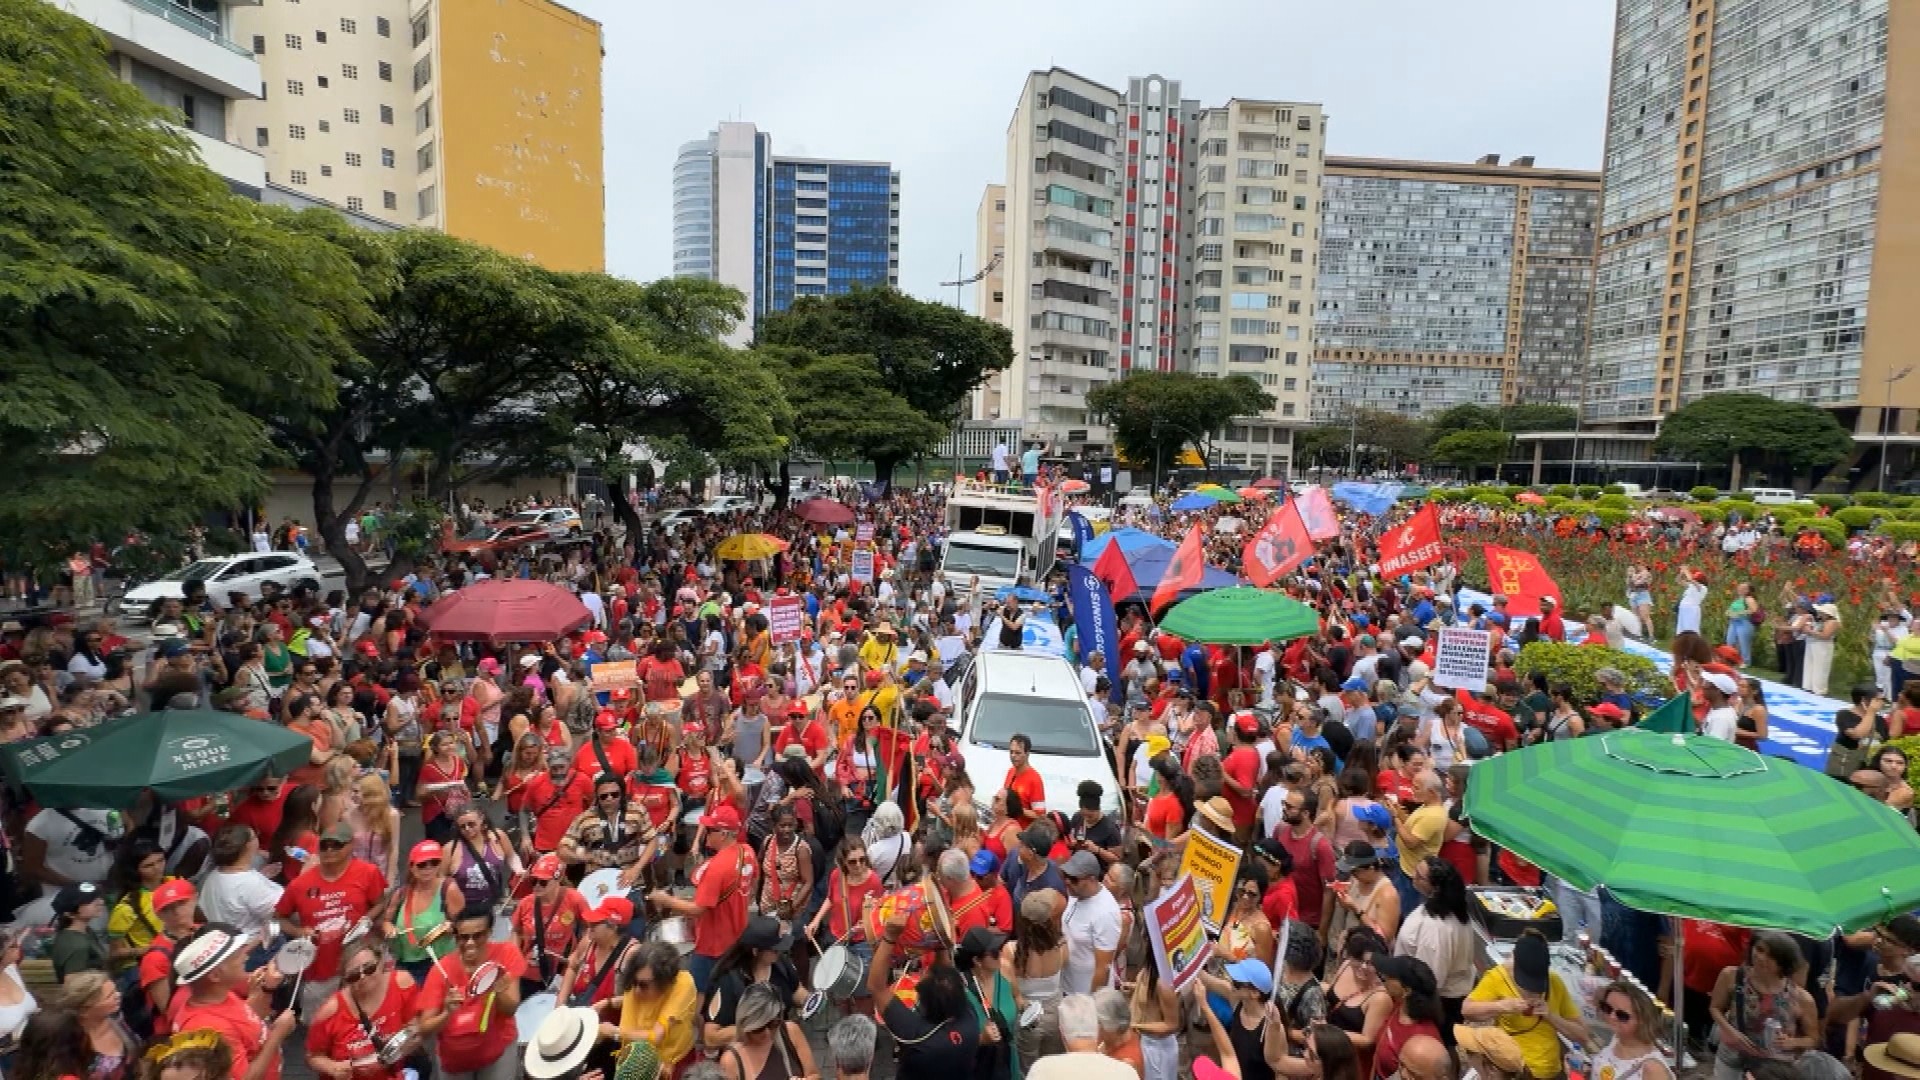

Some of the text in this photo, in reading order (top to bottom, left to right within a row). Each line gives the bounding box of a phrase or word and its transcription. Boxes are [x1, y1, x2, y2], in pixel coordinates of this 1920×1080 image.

[1496, 551, 1521, 595] PCB
[171, 744, 231, 765] XEQUE
[181, 754, 231, 771] MATE
[1191, 833, 1236, 863] CONGRESSO
